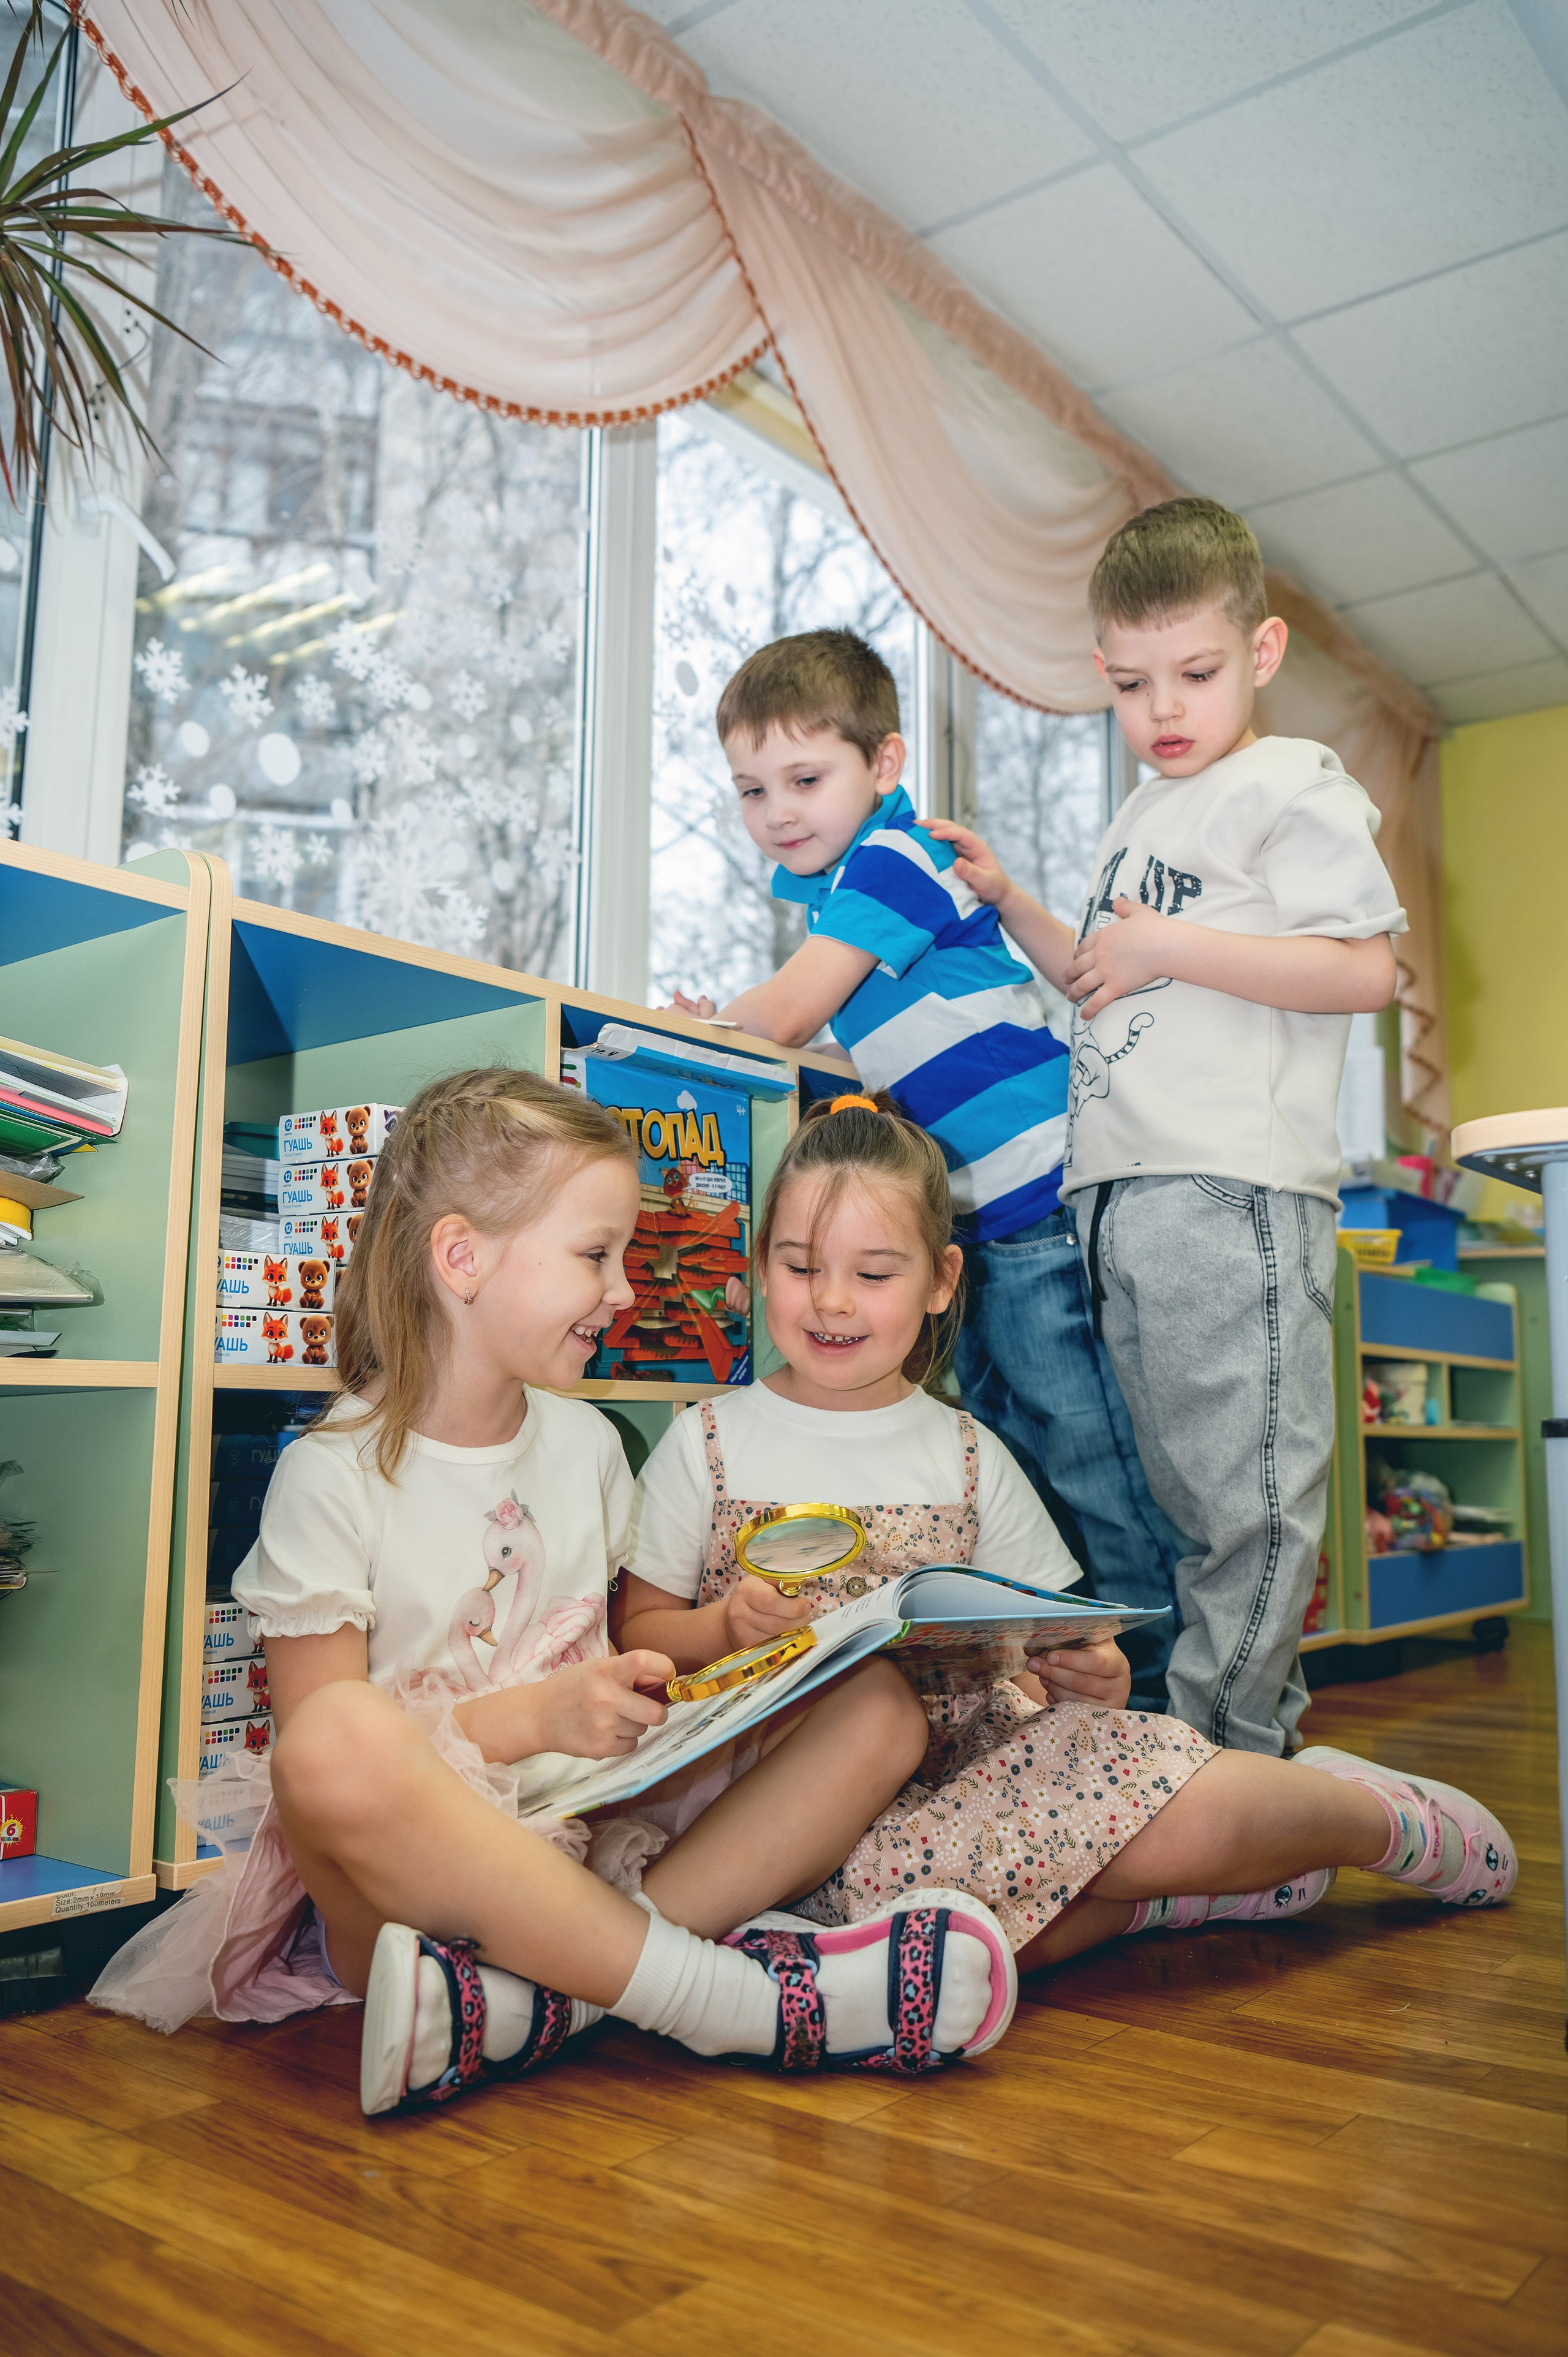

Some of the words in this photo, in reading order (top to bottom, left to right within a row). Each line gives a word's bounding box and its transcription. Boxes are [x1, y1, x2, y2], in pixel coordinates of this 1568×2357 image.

[737, 1104, 745, 1116] 4+
[284, 1137, 312, 1152] ГУАШЬ
[283, 1190, 312, 1204] ГУАШЬ
[284, 1242, 313, 1254] ГУАШЬ
[203, 1633, 234, 1649] АШЬ
[7, 1823, 16, 1836] 6
